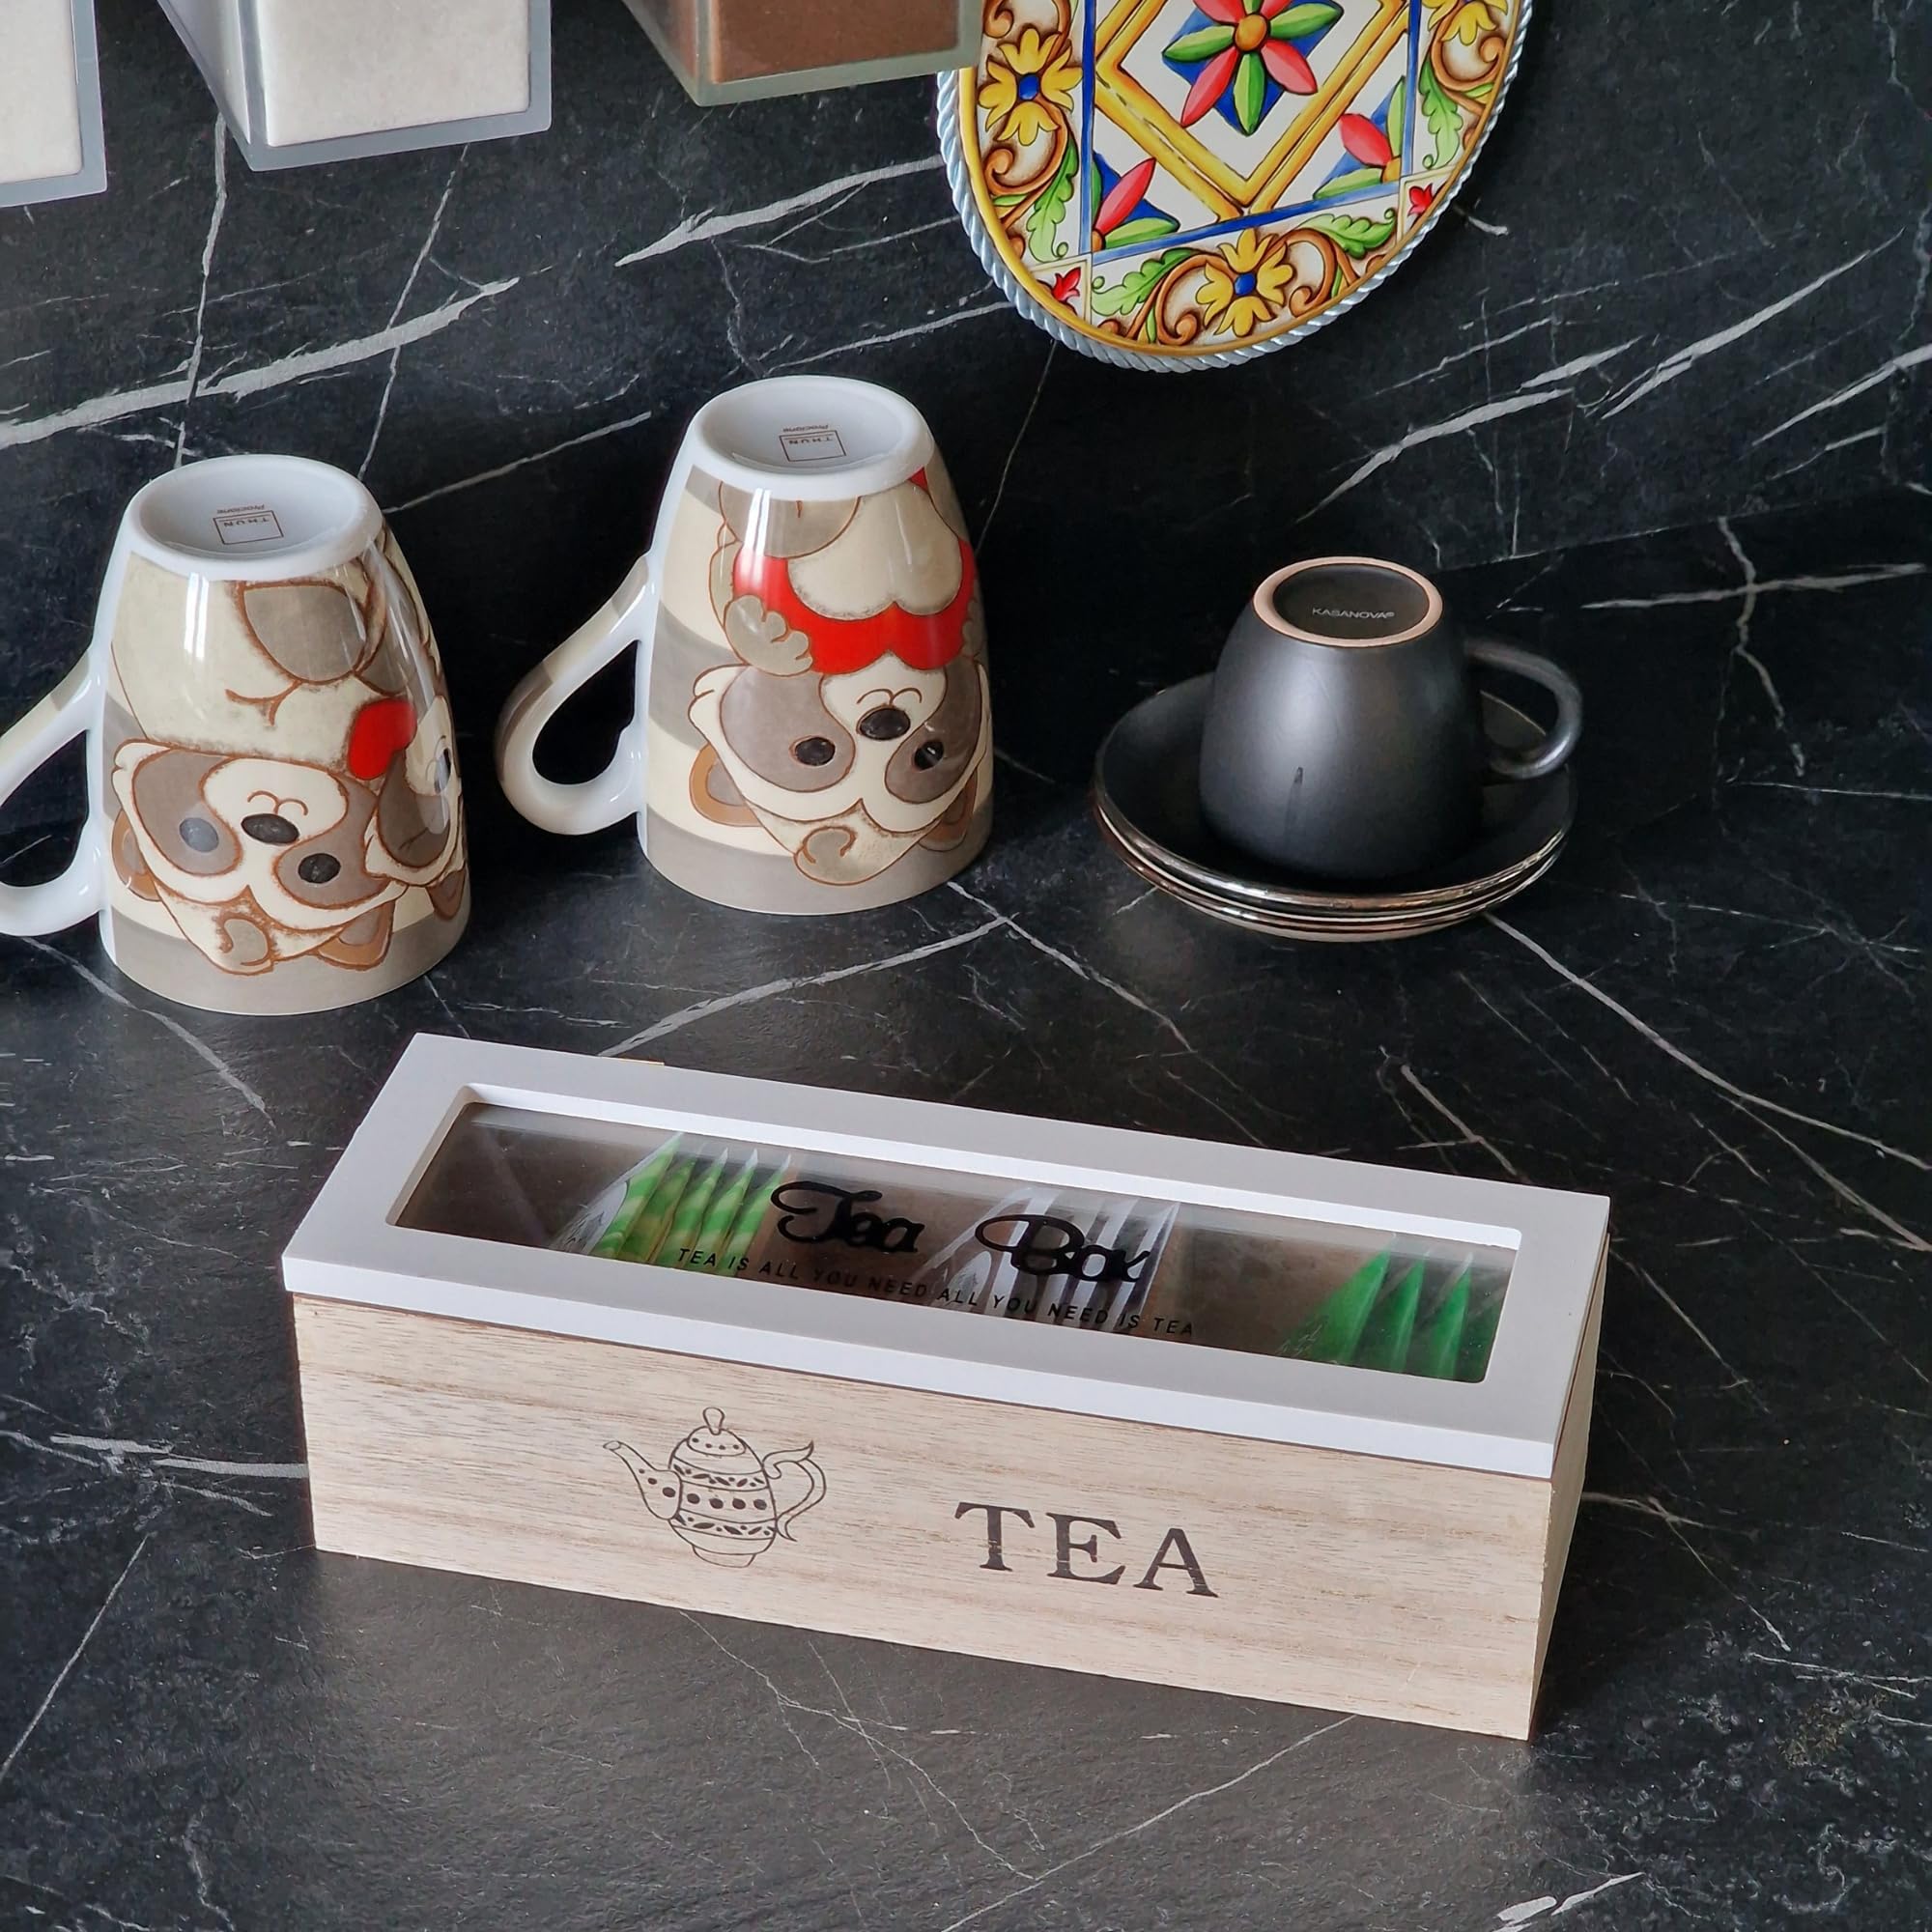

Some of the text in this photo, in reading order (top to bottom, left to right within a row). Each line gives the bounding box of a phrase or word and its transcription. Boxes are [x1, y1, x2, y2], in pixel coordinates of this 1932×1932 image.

[223, 517, 270, 527] THUN
[770, 1180, 1151, 1282] Tea Box
[677, 1248, 1194, 1335] TEA IS ALL YOU NEED ALL YOU NEED IS TEA
[954, 1501, 1219, 1598] TEA
